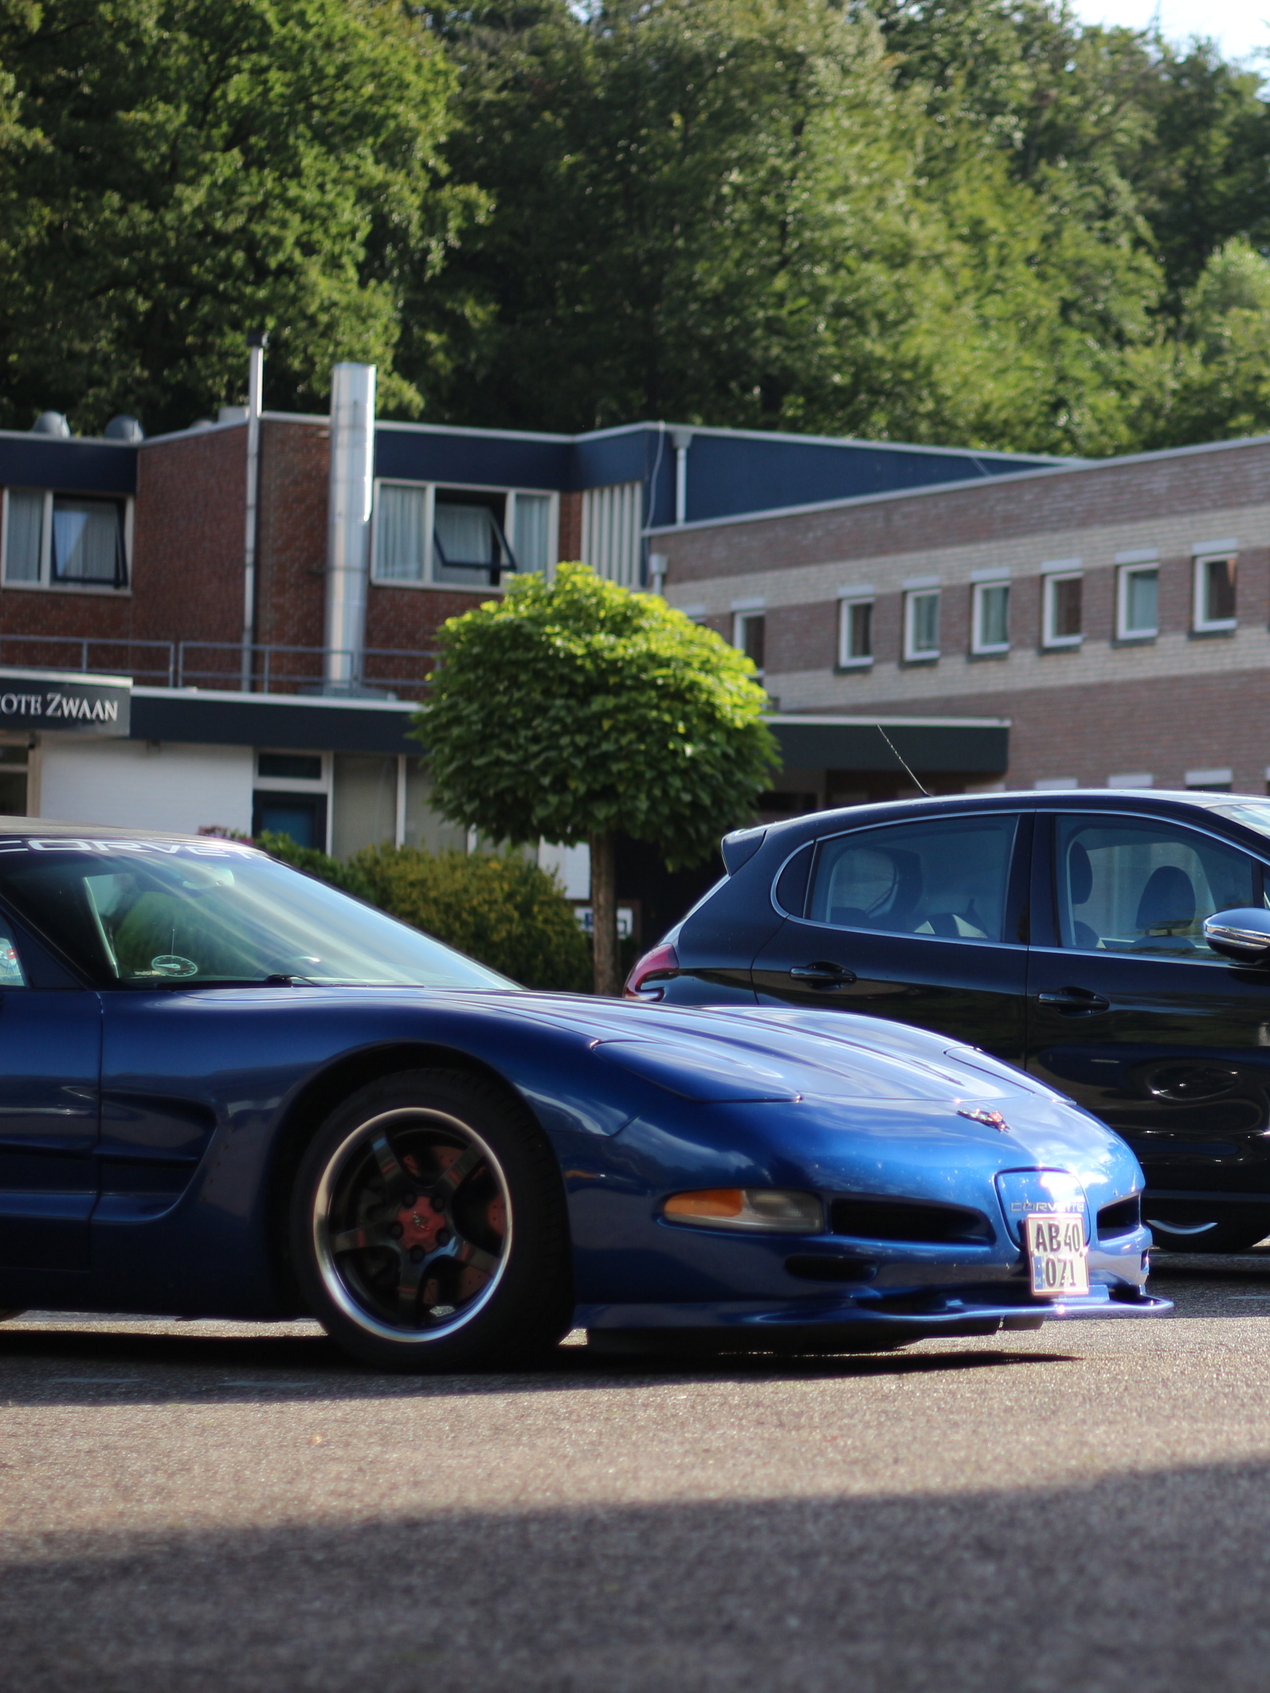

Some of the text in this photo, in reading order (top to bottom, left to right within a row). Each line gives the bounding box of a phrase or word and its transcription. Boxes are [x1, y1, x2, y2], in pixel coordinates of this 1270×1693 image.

[0, 692, 118, 721] OTE ZWAAN
[1010, 1202, 1085, 1212] CORVTTE
[1035, 1221, 1081, 1252] AB 40
[1045, 1256, 1077, 1287] 071
